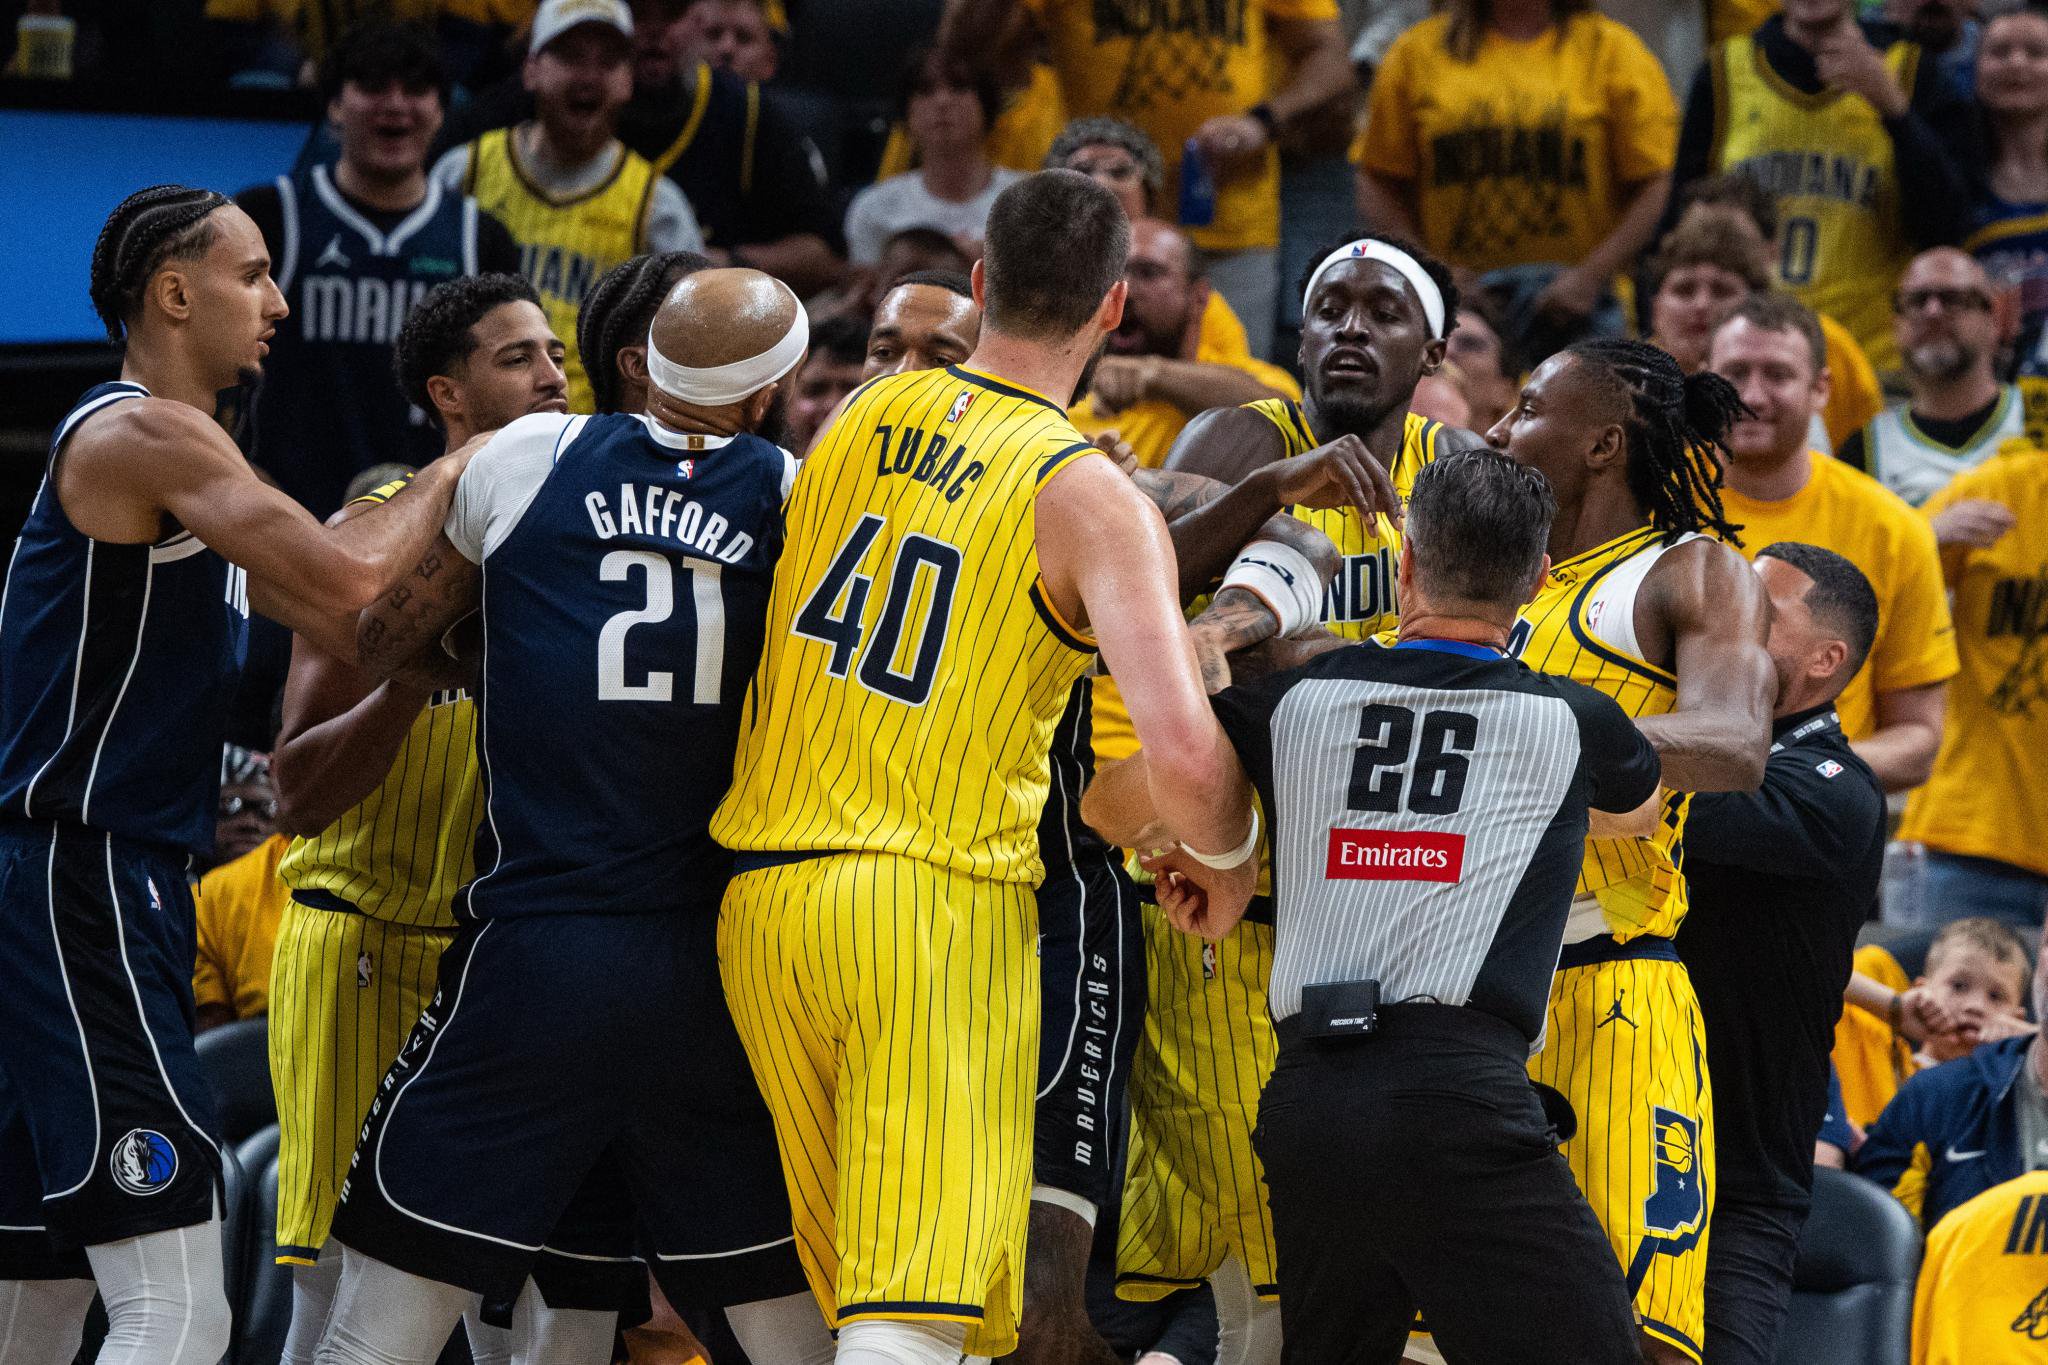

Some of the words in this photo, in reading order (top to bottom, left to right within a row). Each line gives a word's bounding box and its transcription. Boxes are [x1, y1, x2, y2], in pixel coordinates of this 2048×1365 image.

[302, 274, 428, 344] MAV
[876, 425, 985, 504] ZUBAC
[584, 482, 755, 565] GAFFORD
[597, 549, 726, 705] 21
[790, 511, 964, 708] 40
[1318, 546, 1400, 625] NDI
[1346, 703, 1480, 816] 26
[1340, 841, 1449, 869] Emirates
[1074, 953, 1110, 1166] MAVERICKS
